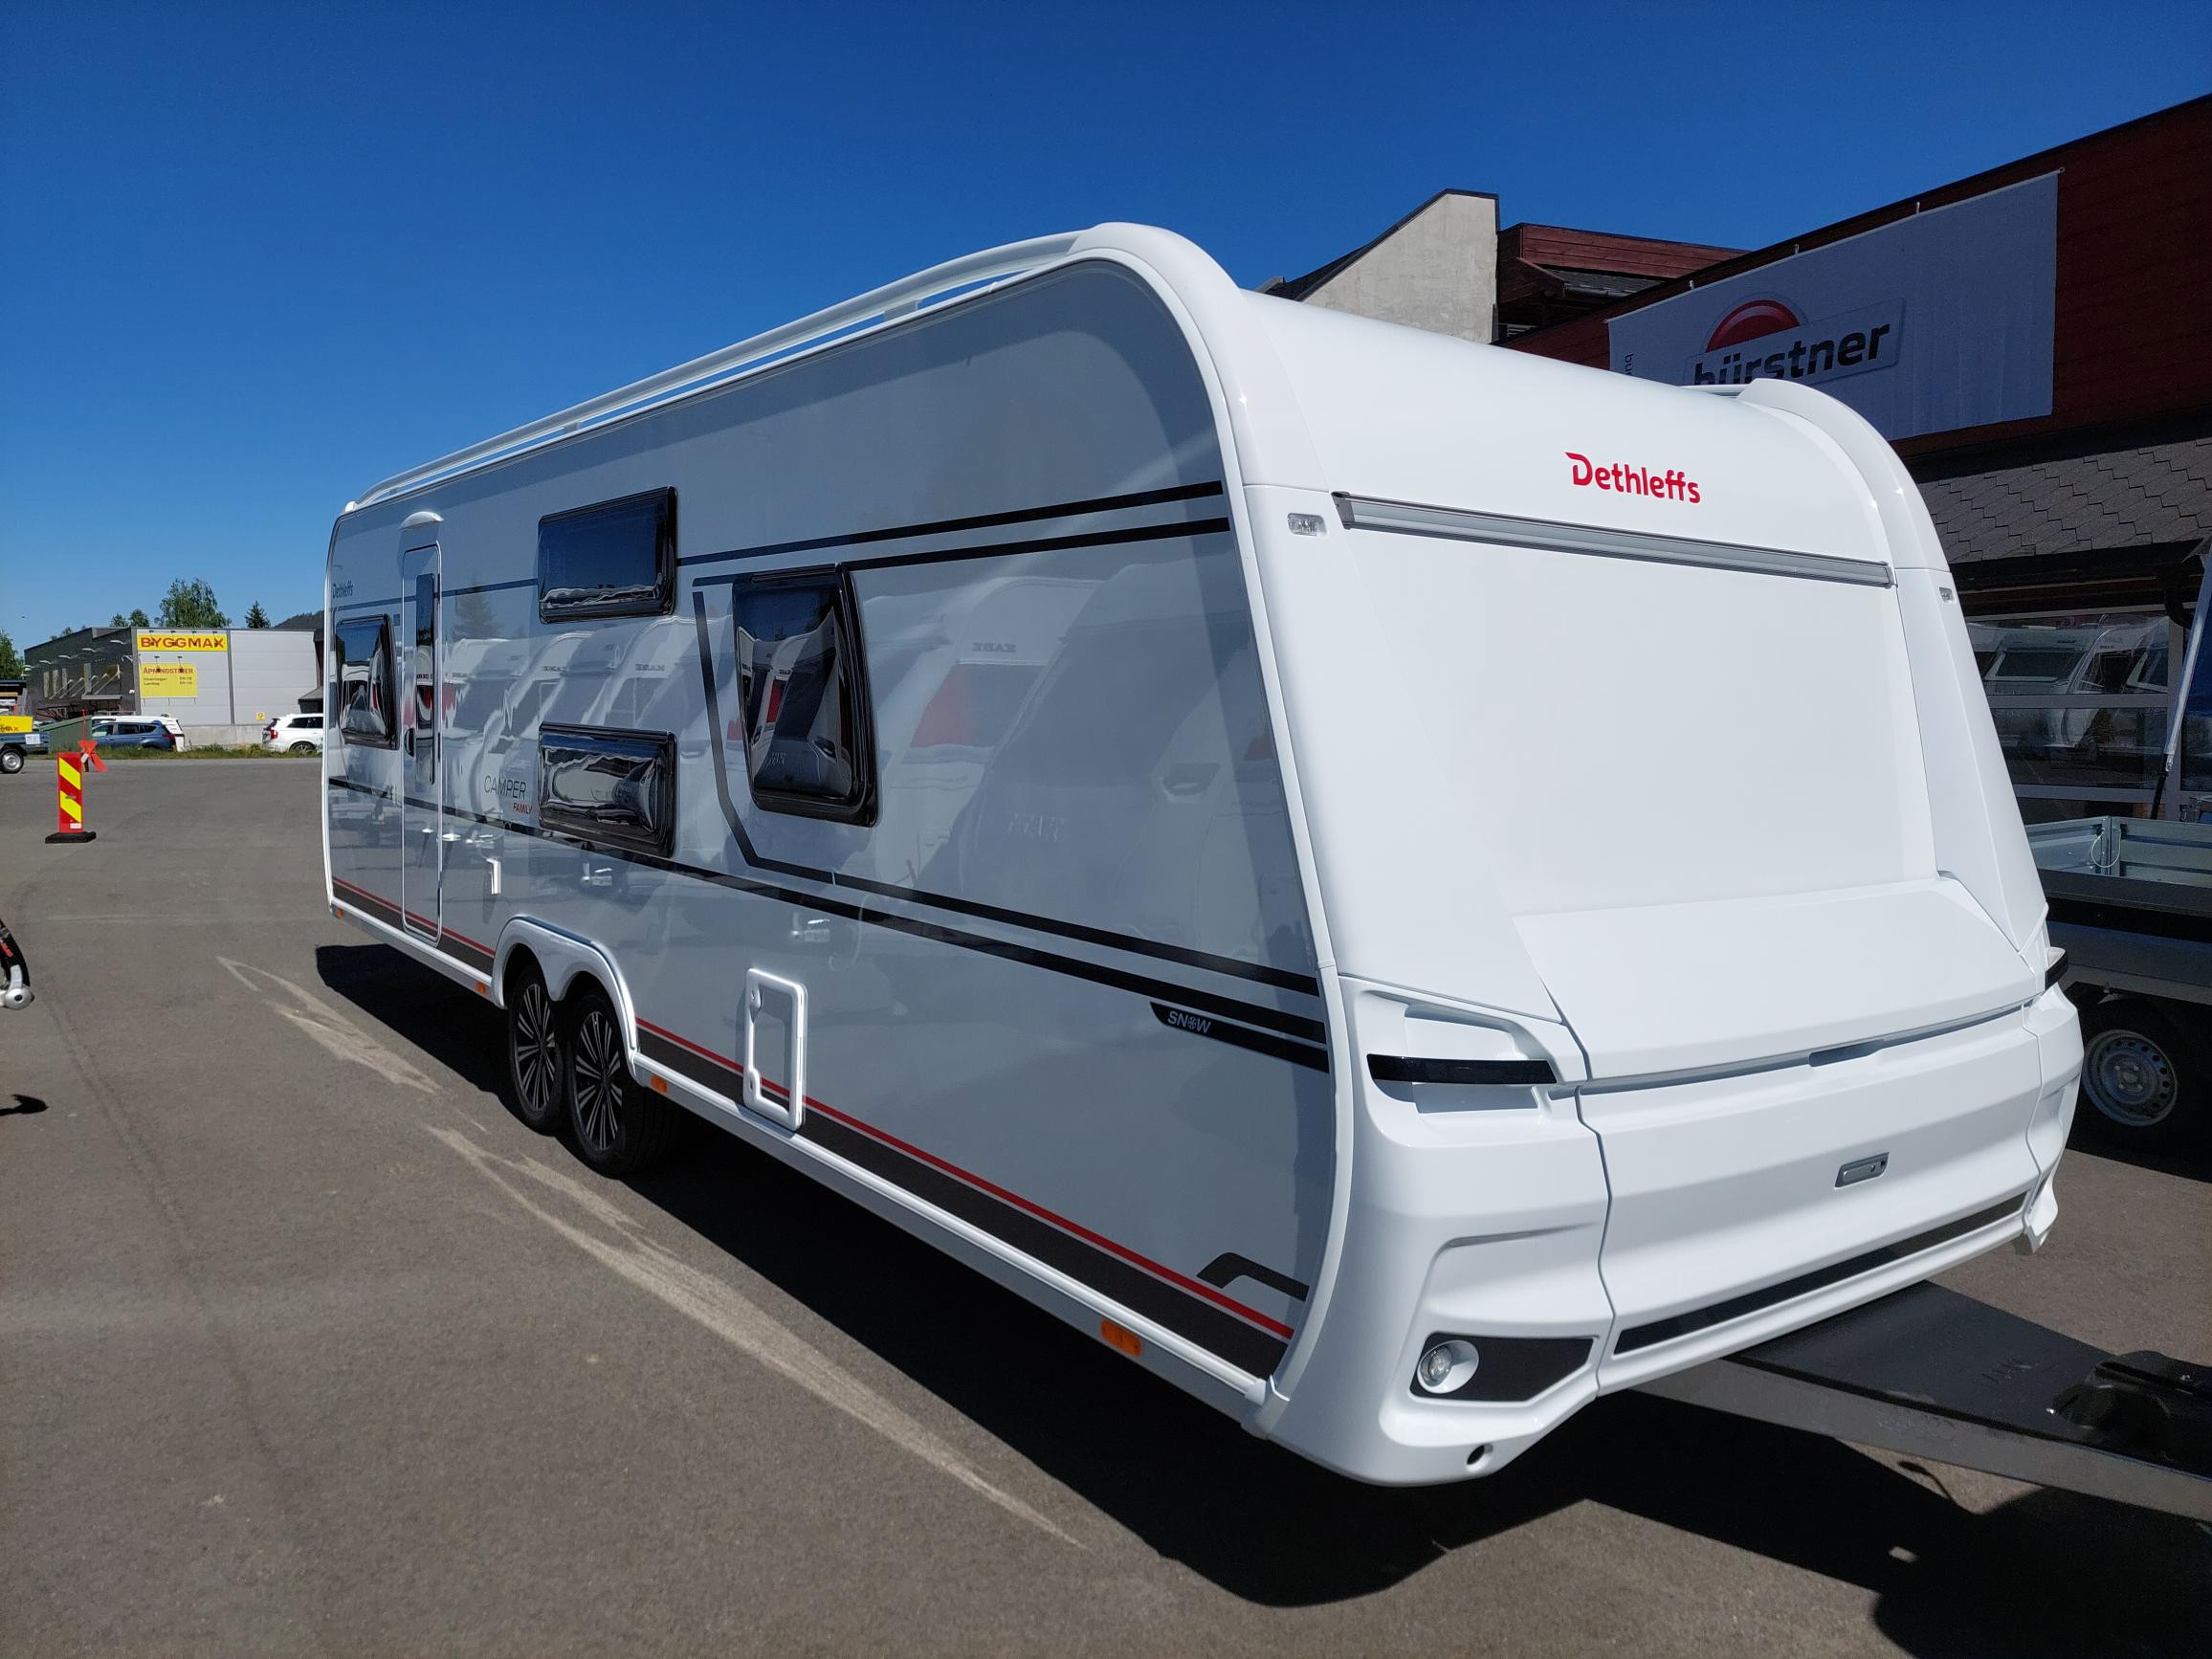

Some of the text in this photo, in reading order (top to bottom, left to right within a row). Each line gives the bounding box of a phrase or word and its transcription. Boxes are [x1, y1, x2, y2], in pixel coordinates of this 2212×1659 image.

[1564, 452, 1701, 504] Dethleffs
[141, 637, 224, 648] BYGGMAX
[484, 775, 527, 801] CAMPER
[513, 802, 533, 814] FAMILY
